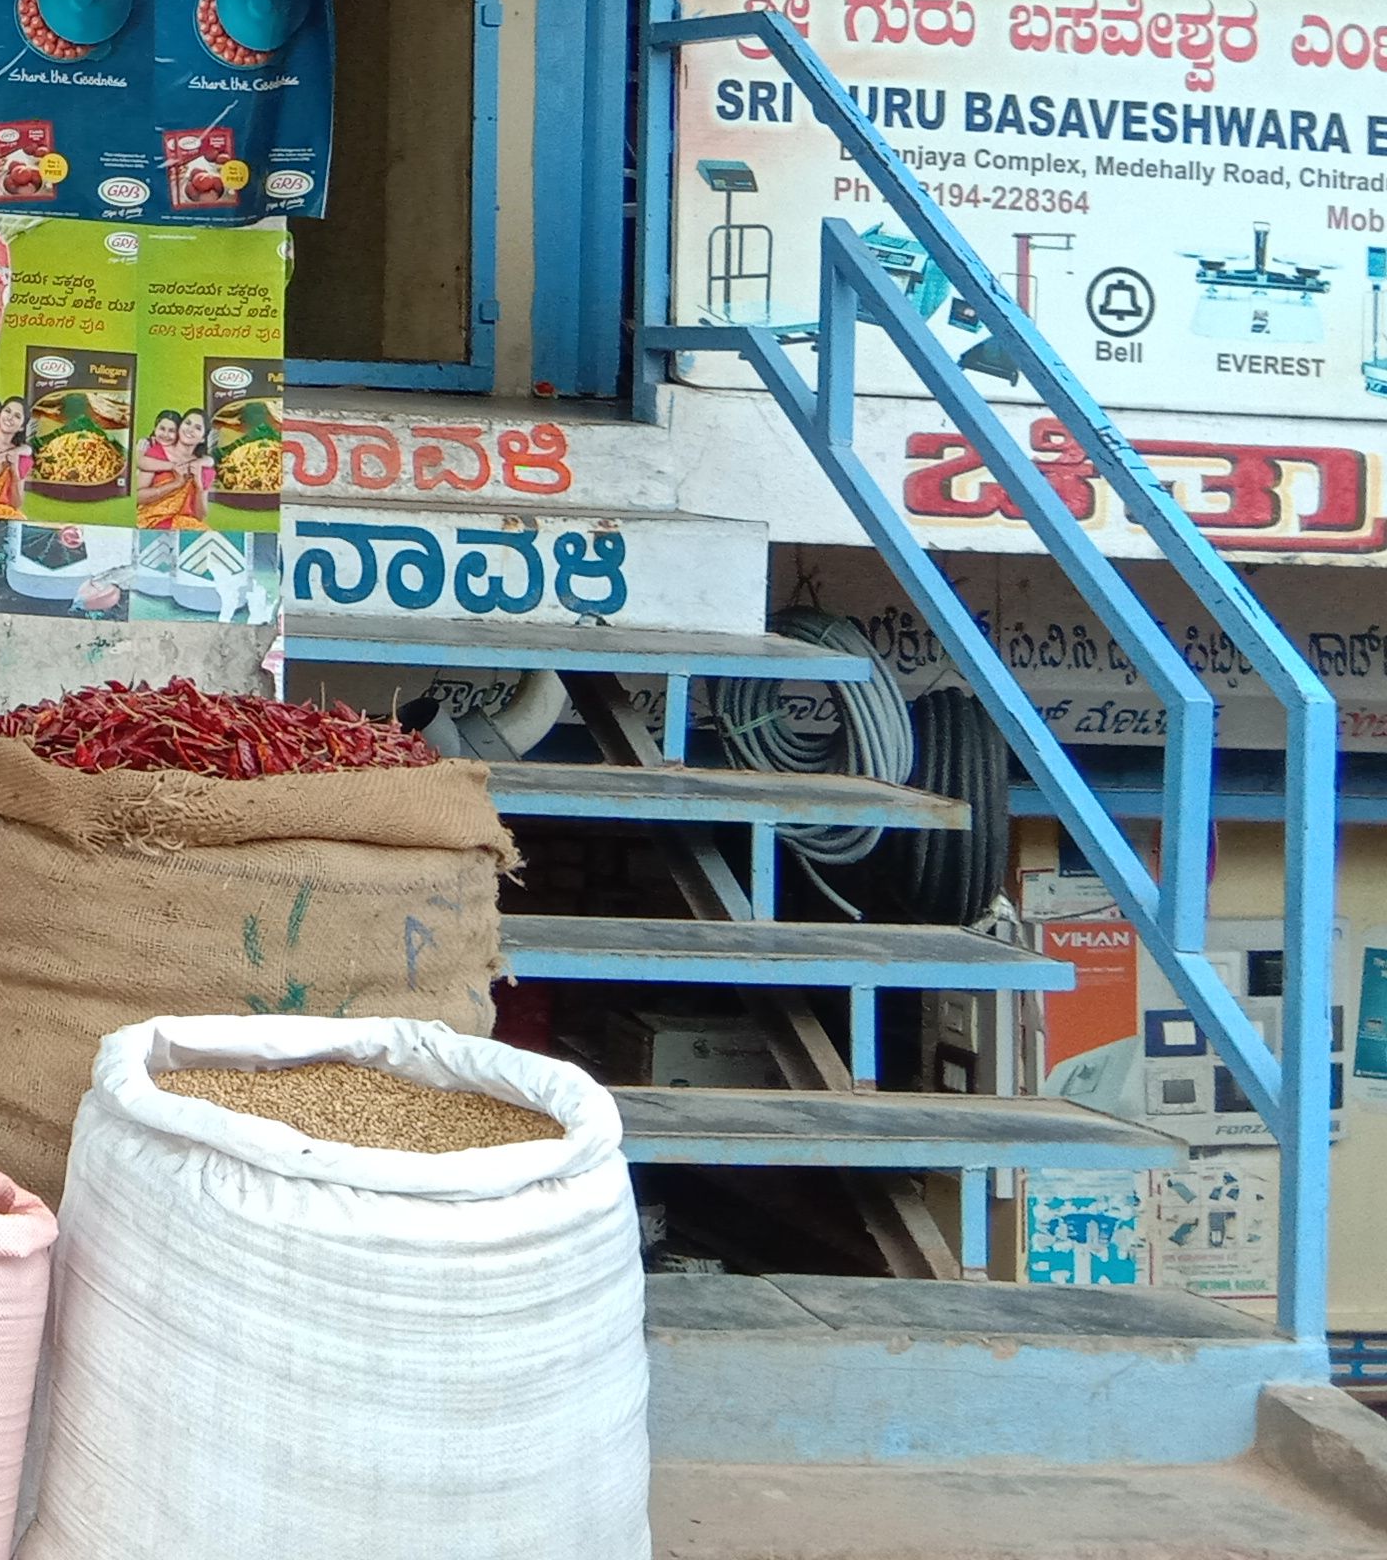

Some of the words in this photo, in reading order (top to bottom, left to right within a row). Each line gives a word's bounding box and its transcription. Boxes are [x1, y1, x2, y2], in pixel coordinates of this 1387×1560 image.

[715, 78, 793, 124] SRI
[964, 89, 1353, 156] BASAVESHWARA
[269, 175, 305, 192] GRB
[974, 150, 1088, 179] Complex,
[1095, 155, 1216, 187] Medehally
[1224, 163, 1292, 189] Road,
[1299, 166, 1387, 193] Chitrad
[107, 183, 143, 201] GRB
[834, 176, 871, 203] Ph
[919, 181, 1092, 216] 194-228364
[1327, 204, 1385, 233] Mob
[1095, 339, 1144, 364] Bell
[1215, 351, 1326, 379] EVEREST
[1049, 930, 1131, 948] VIHAN
